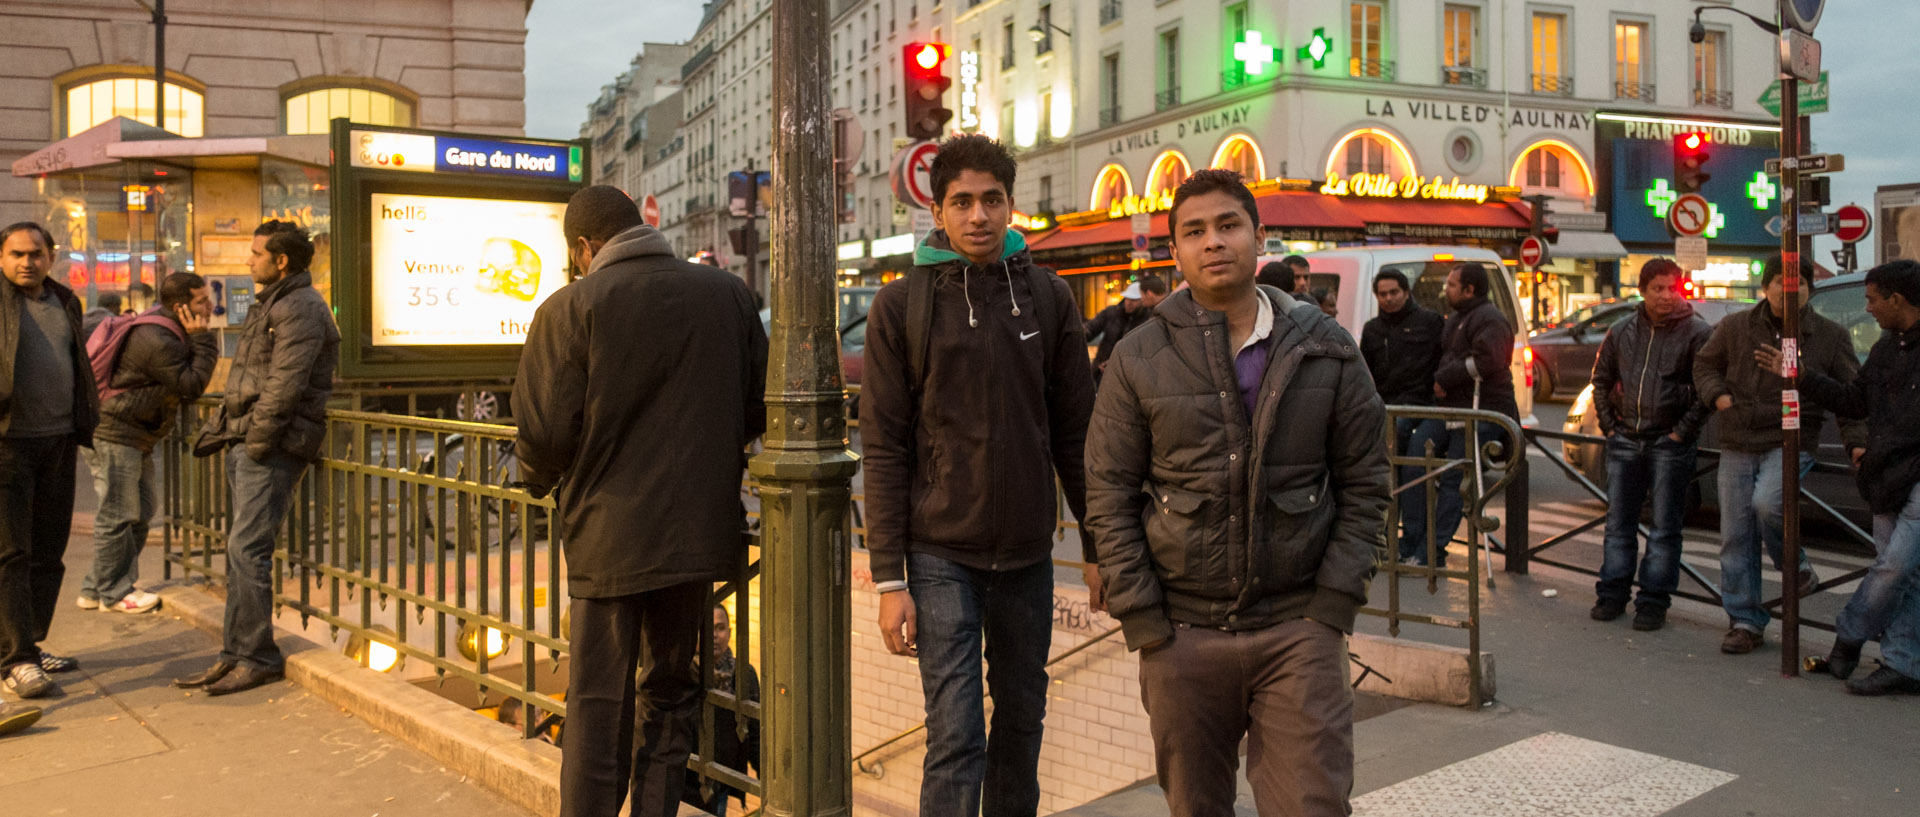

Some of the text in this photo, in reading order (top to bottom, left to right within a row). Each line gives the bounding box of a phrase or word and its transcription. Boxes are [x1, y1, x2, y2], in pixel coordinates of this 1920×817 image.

[1366, 98, 1395, 117] LA
[1108, 104, 1251, 155] LA VILLE D'AULNAY
[445, 146, 556, 172] Gare du Nord
[1320, 171, 1489, 205] La Ville D'Aulnay
[404, 259, 465, 275] Venise
